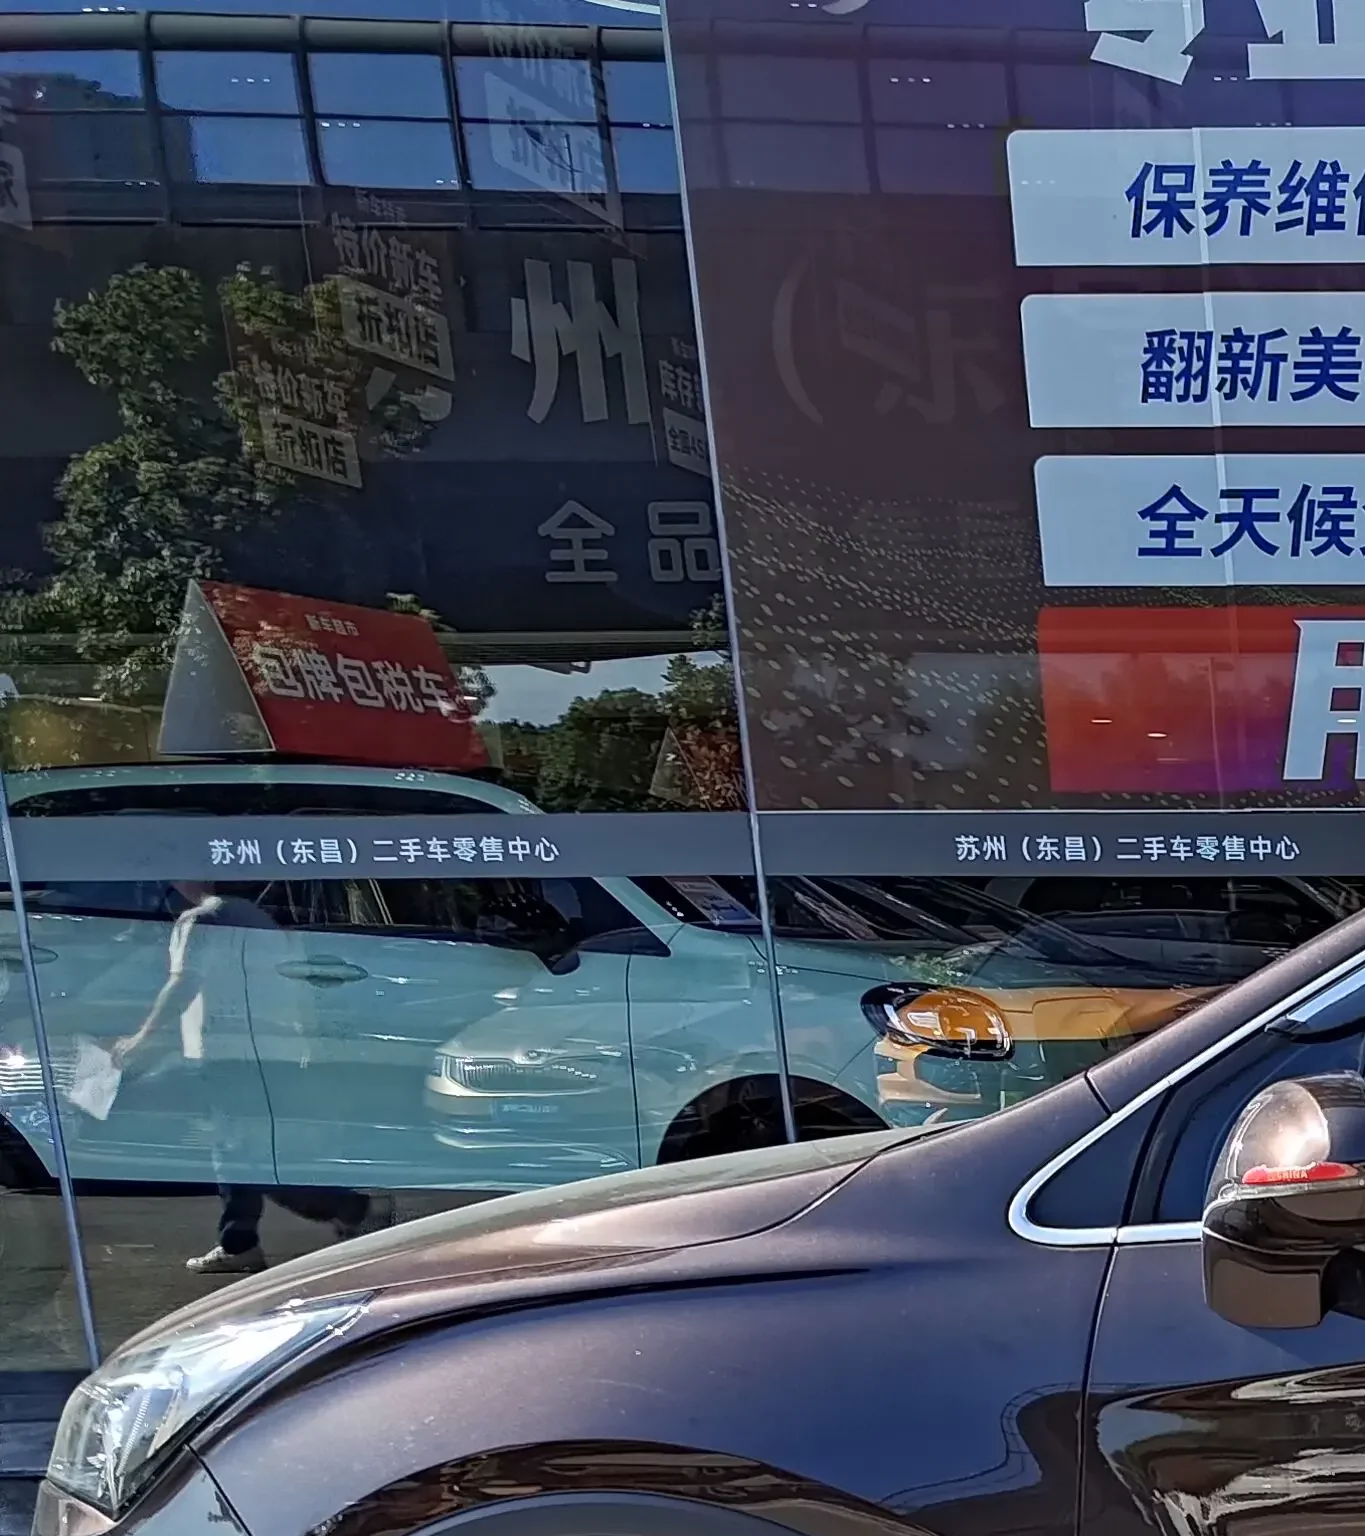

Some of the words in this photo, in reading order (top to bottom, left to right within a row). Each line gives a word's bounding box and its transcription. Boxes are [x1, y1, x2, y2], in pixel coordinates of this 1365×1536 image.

[255, 647, 456, 716] 包牌包税车
[208, 837, 560, 866] 苏州（东昌）二手车零售中心
[955, 834, 1301, 863] 苏州（东昌）二手车零售中心
